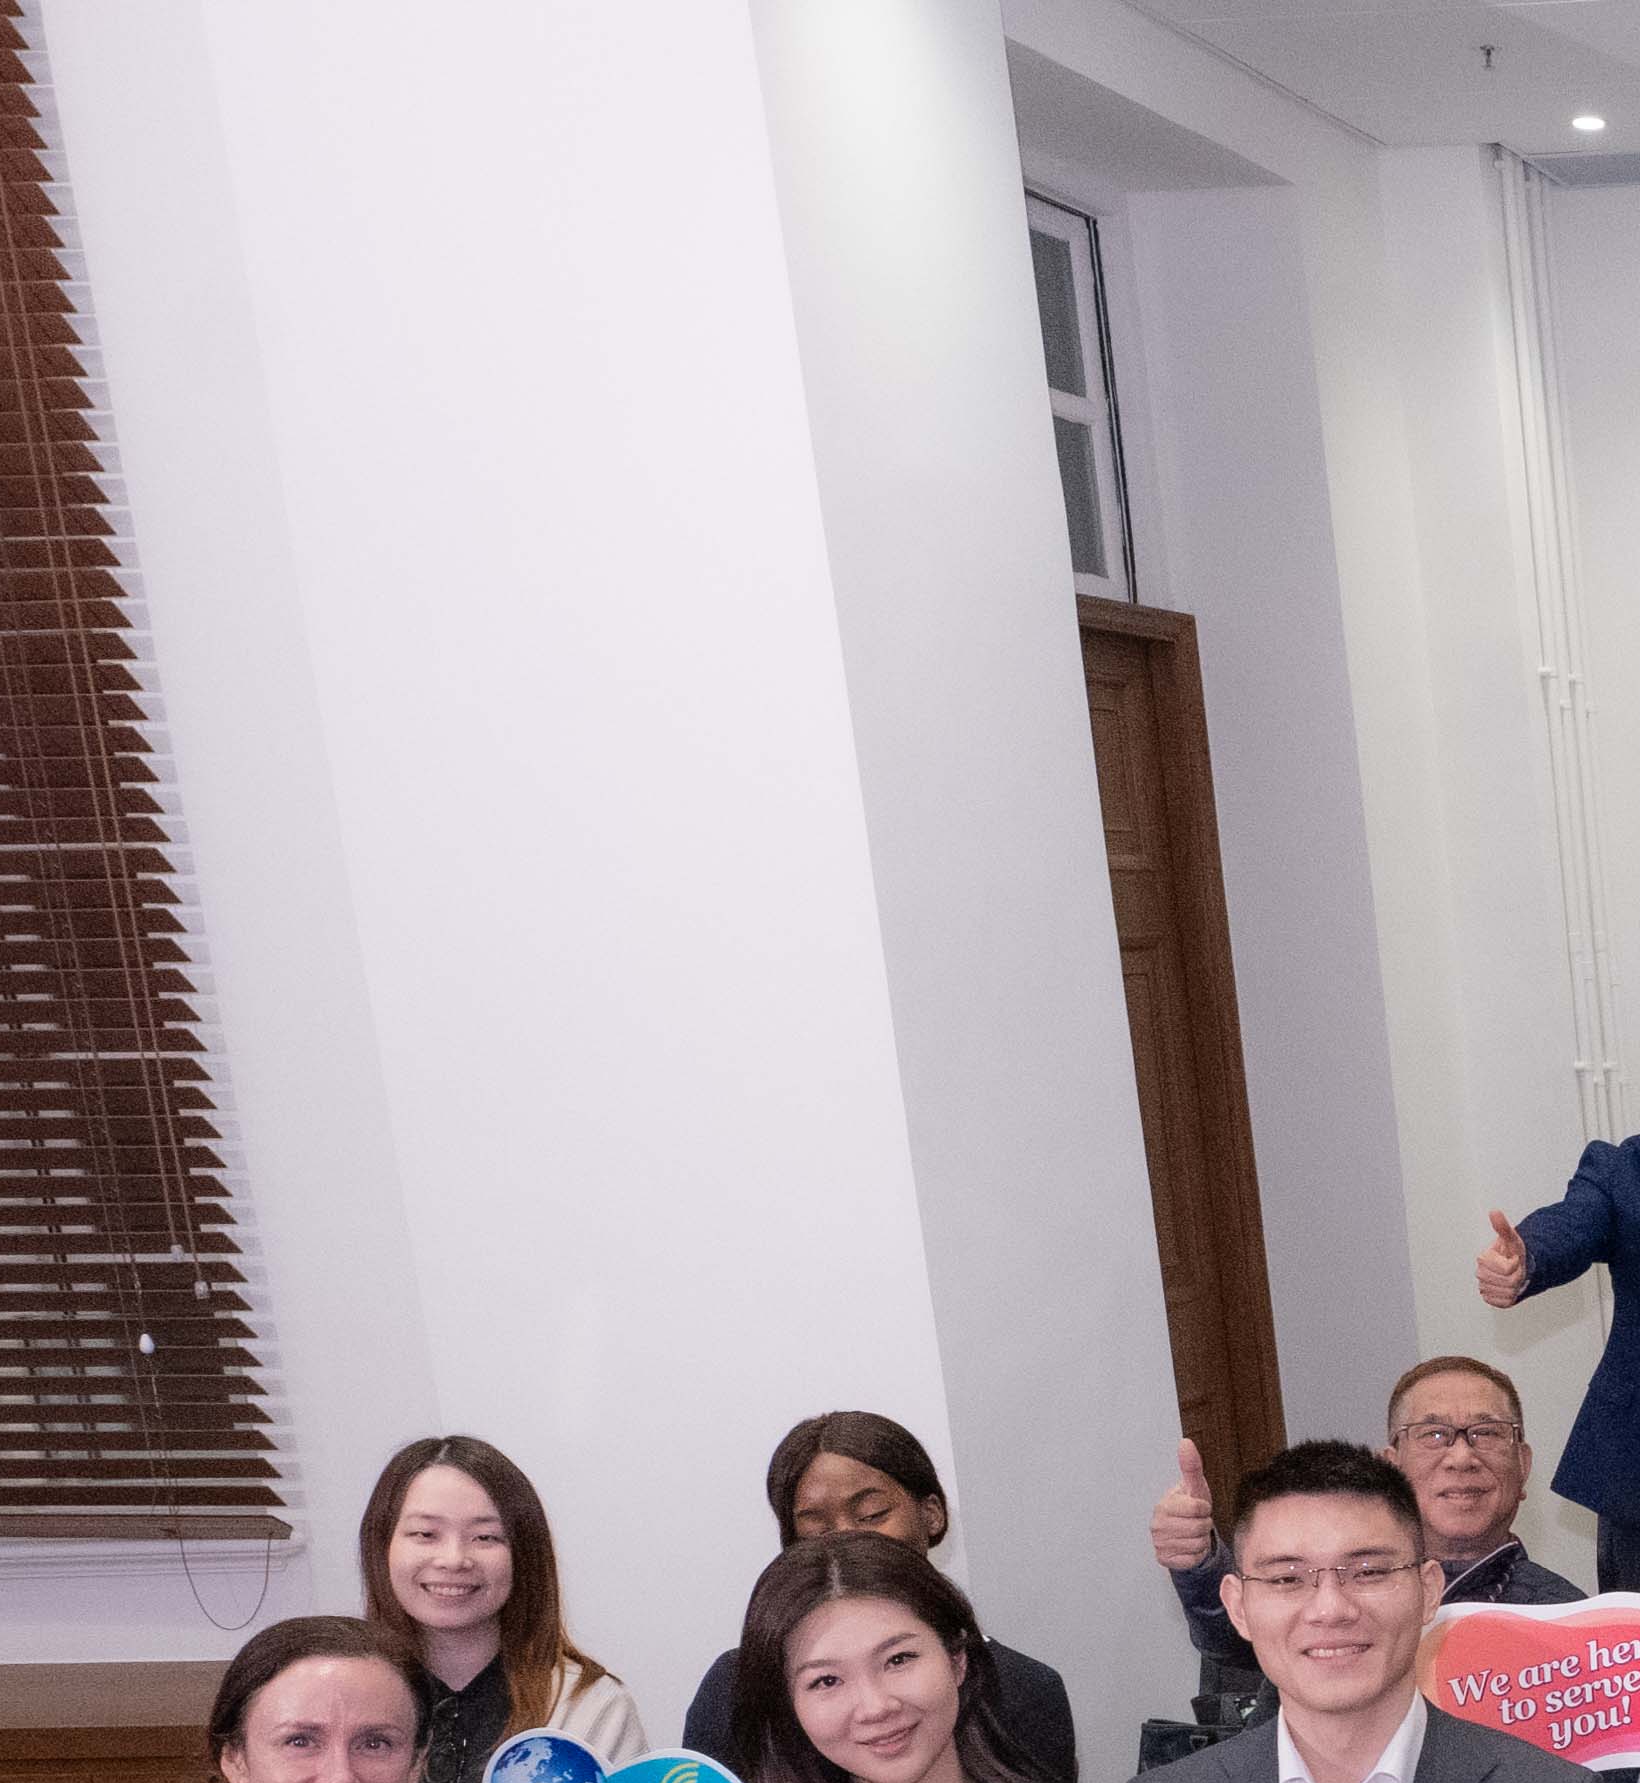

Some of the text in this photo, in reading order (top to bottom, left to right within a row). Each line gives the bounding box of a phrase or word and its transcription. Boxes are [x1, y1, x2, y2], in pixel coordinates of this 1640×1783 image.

[1448, 1669, 1511, 1706] We
[1518, 1655, 1581, 1689] are
[1498, 1697, 1537, 1725] to
[1548, 1695, 1633, 1750] you!
